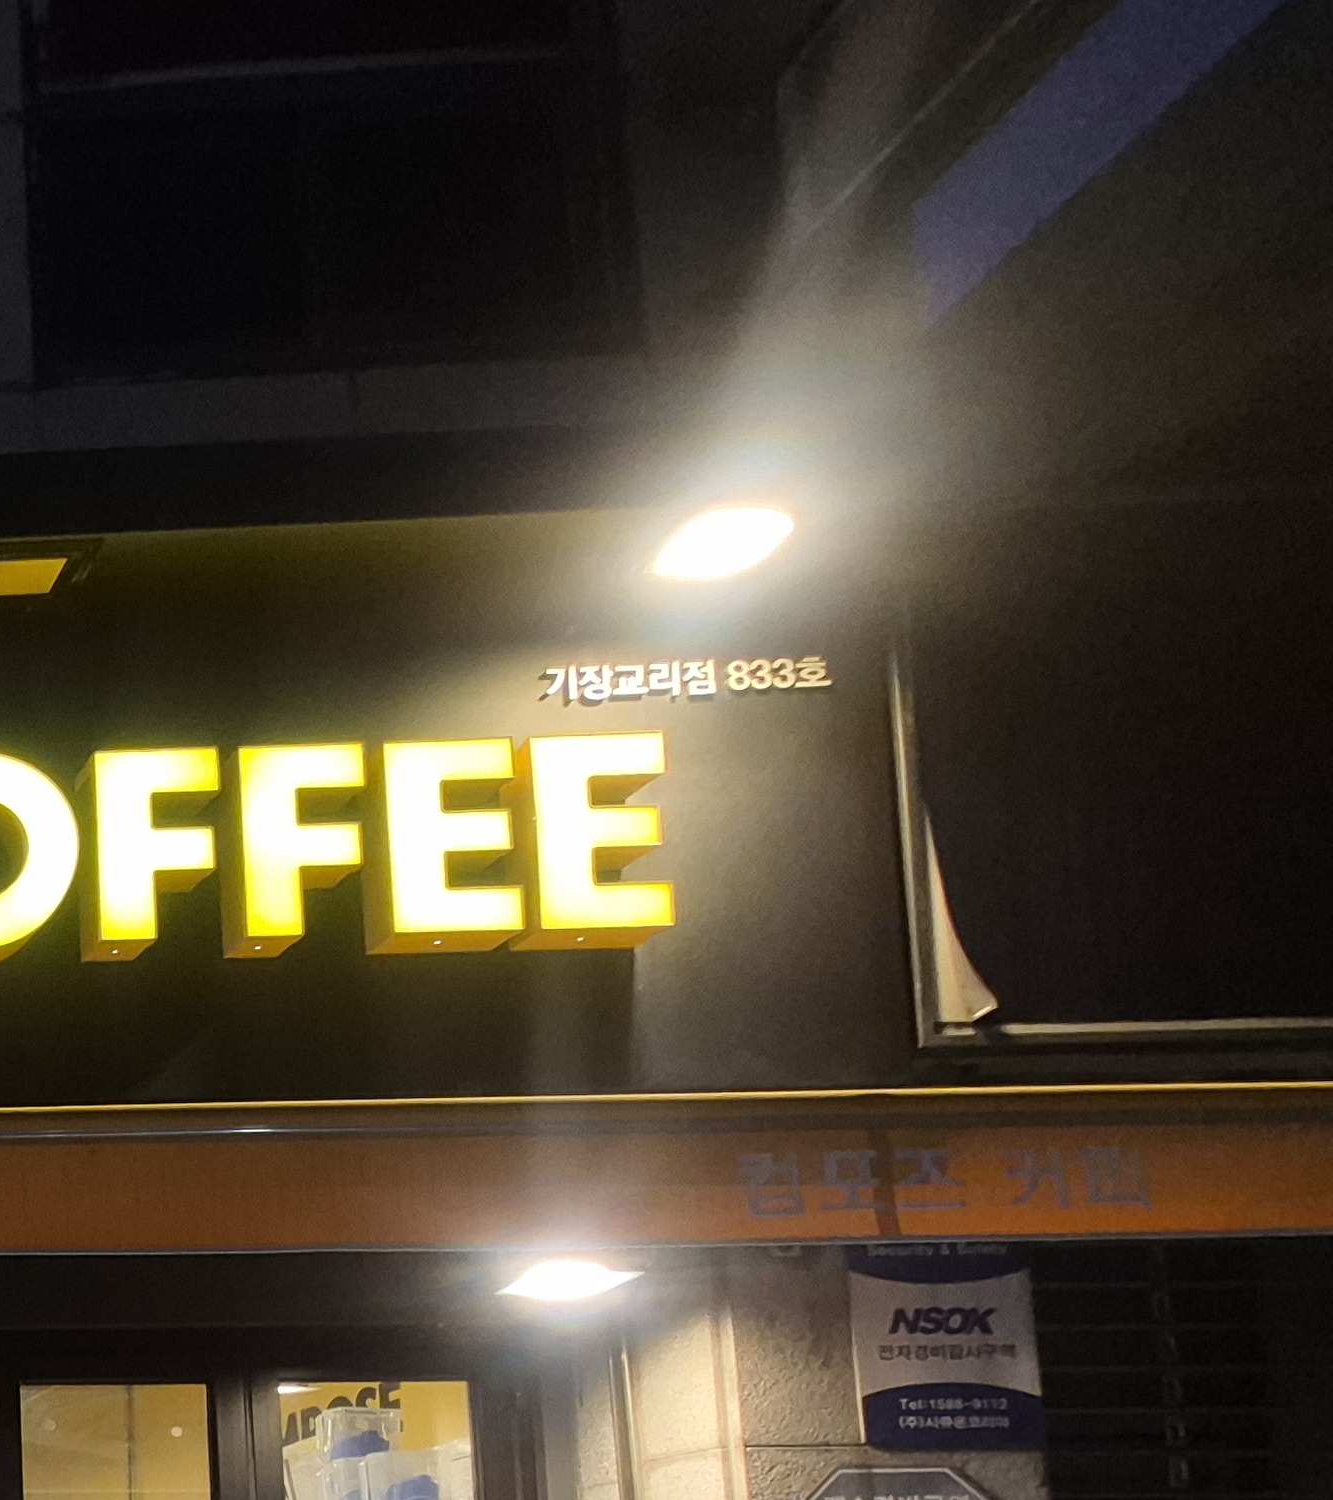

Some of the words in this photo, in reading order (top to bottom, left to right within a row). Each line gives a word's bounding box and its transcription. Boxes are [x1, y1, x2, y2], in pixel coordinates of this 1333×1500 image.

[544, 658, 718, 701] 기장교리점
[726, 656, 833, 691] 833호
[889, 1306, 997, 1336] NSOK
